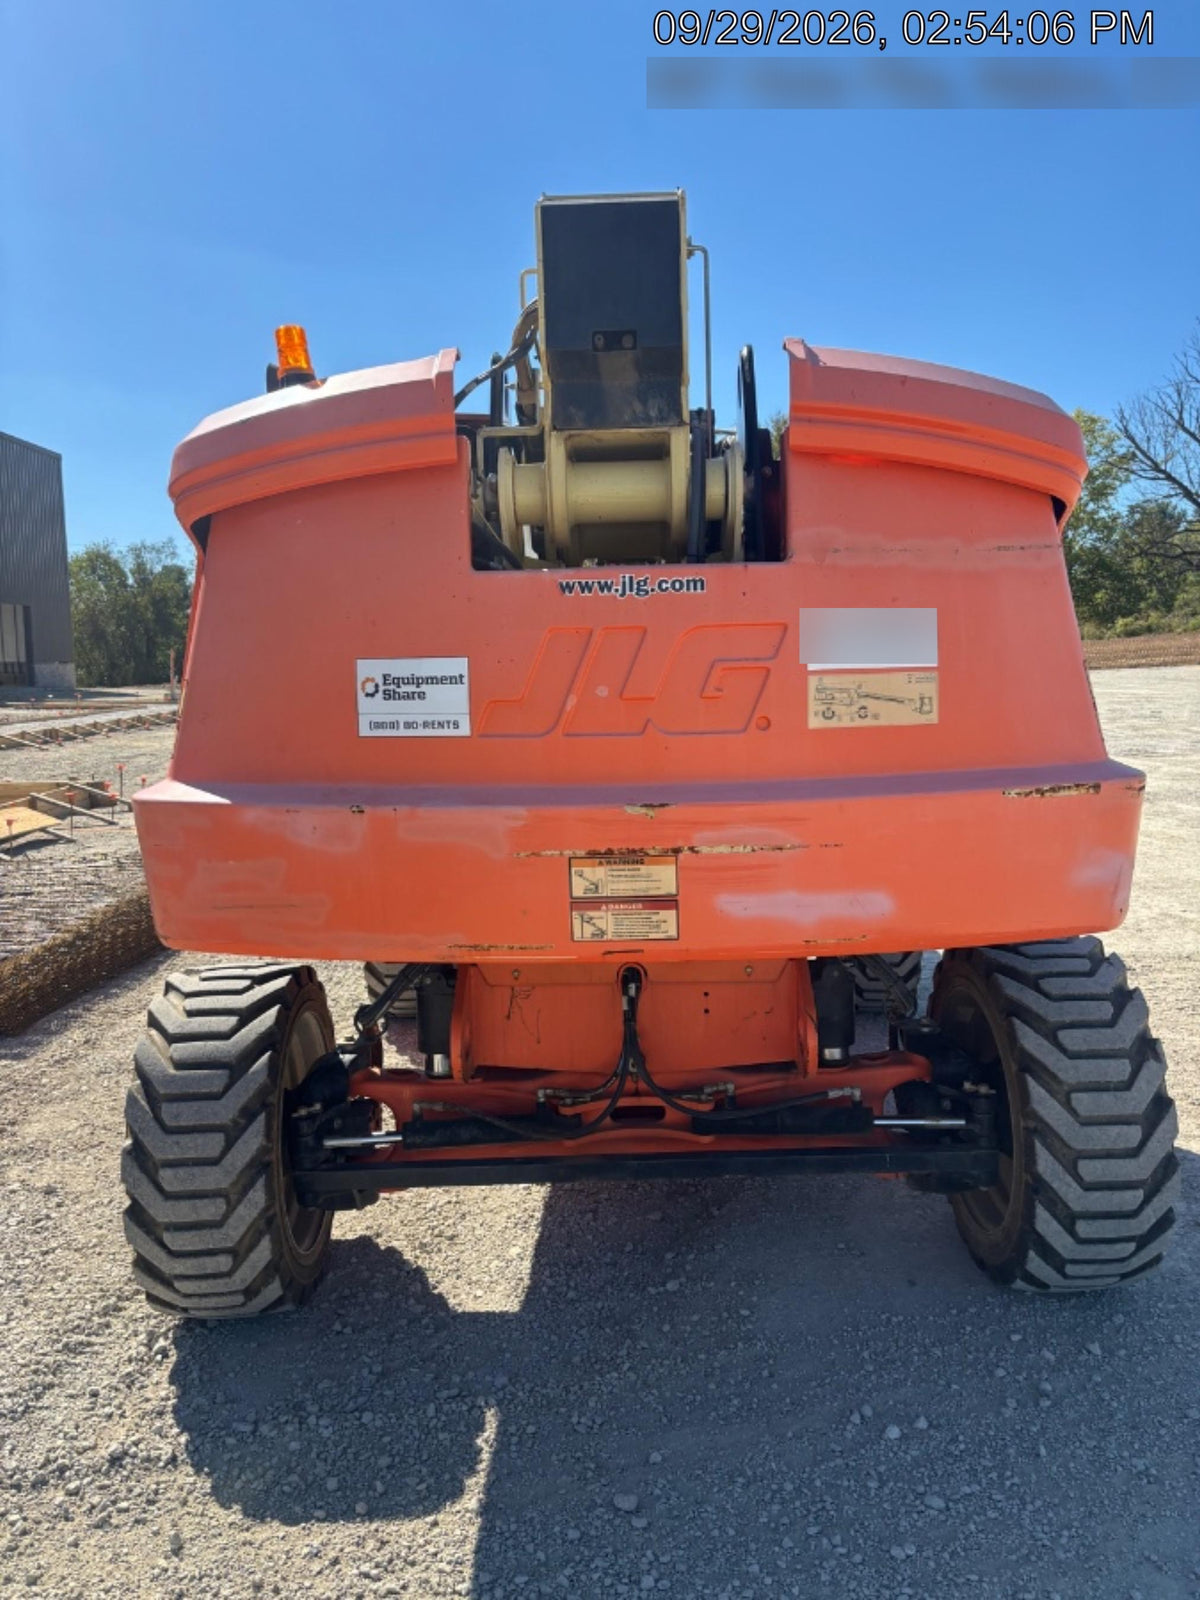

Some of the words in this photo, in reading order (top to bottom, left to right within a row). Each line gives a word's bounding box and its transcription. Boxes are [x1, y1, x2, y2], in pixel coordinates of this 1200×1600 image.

[559, 575, 705, 598] www.jlg.com
[382, 673, 465, 688] Equipment
[383, 689, 427, 701] Share
